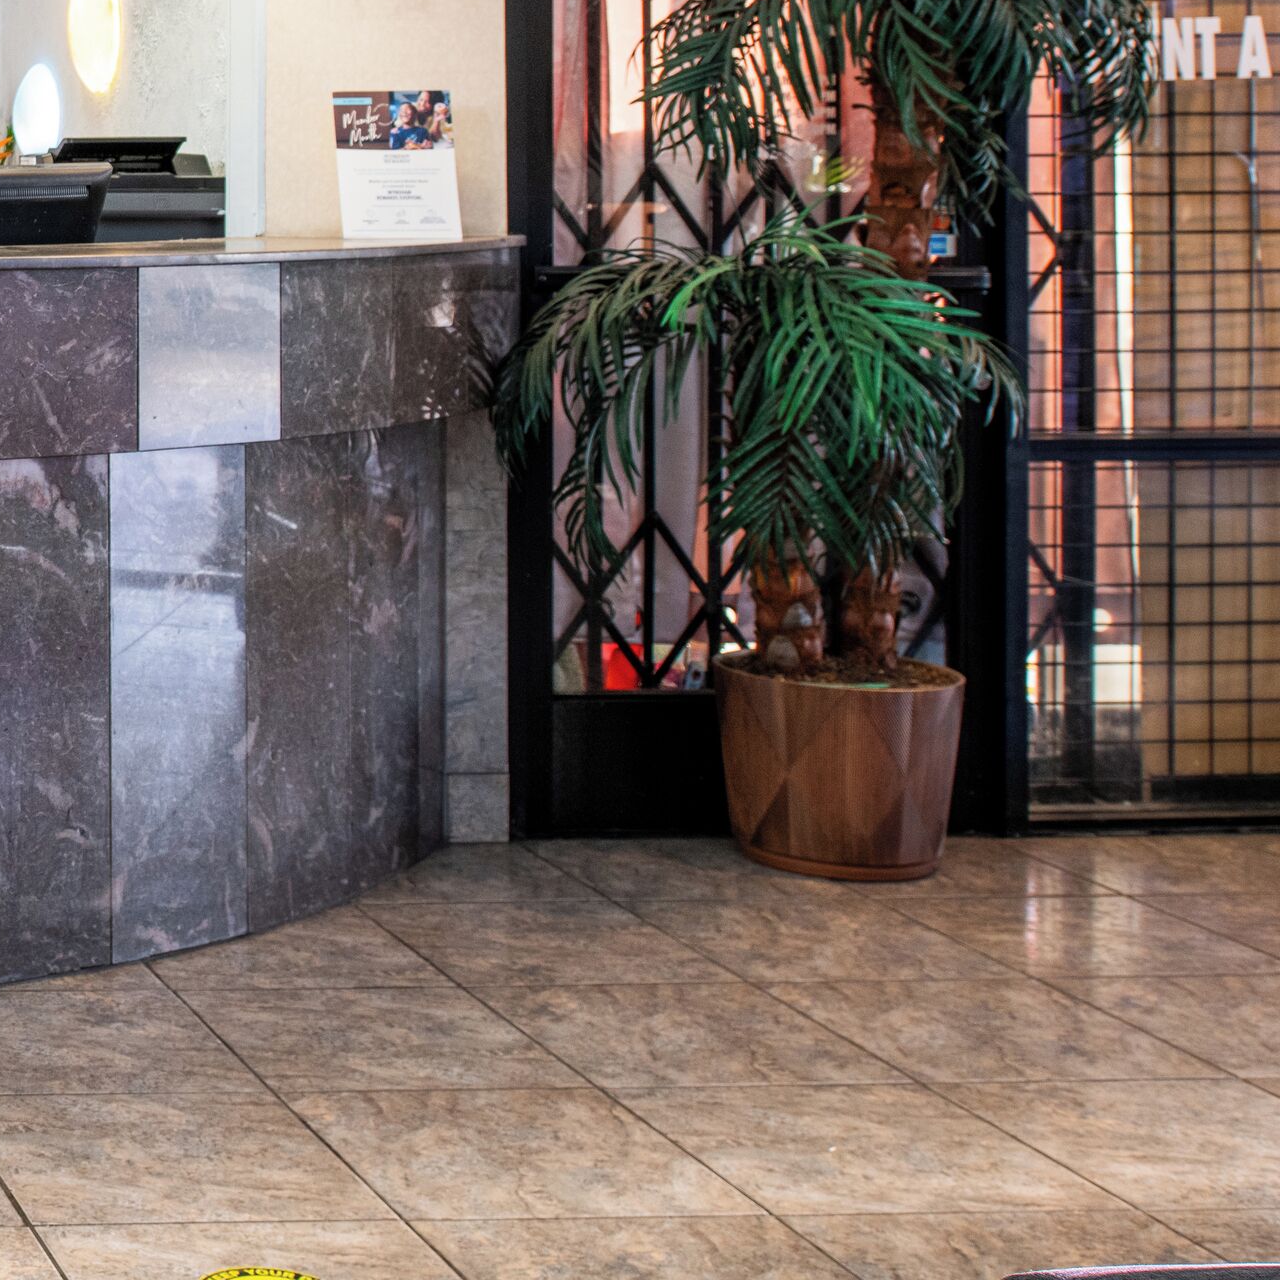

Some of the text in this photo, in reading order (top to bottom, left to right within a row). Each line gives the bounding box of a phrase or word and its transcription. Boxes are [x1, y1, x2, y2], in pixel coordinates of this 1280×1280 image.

[1237, 15, 1272, 79] A
[349, 123, 383, 147] Month
[243, 1268, 296, 1280] YOUR
